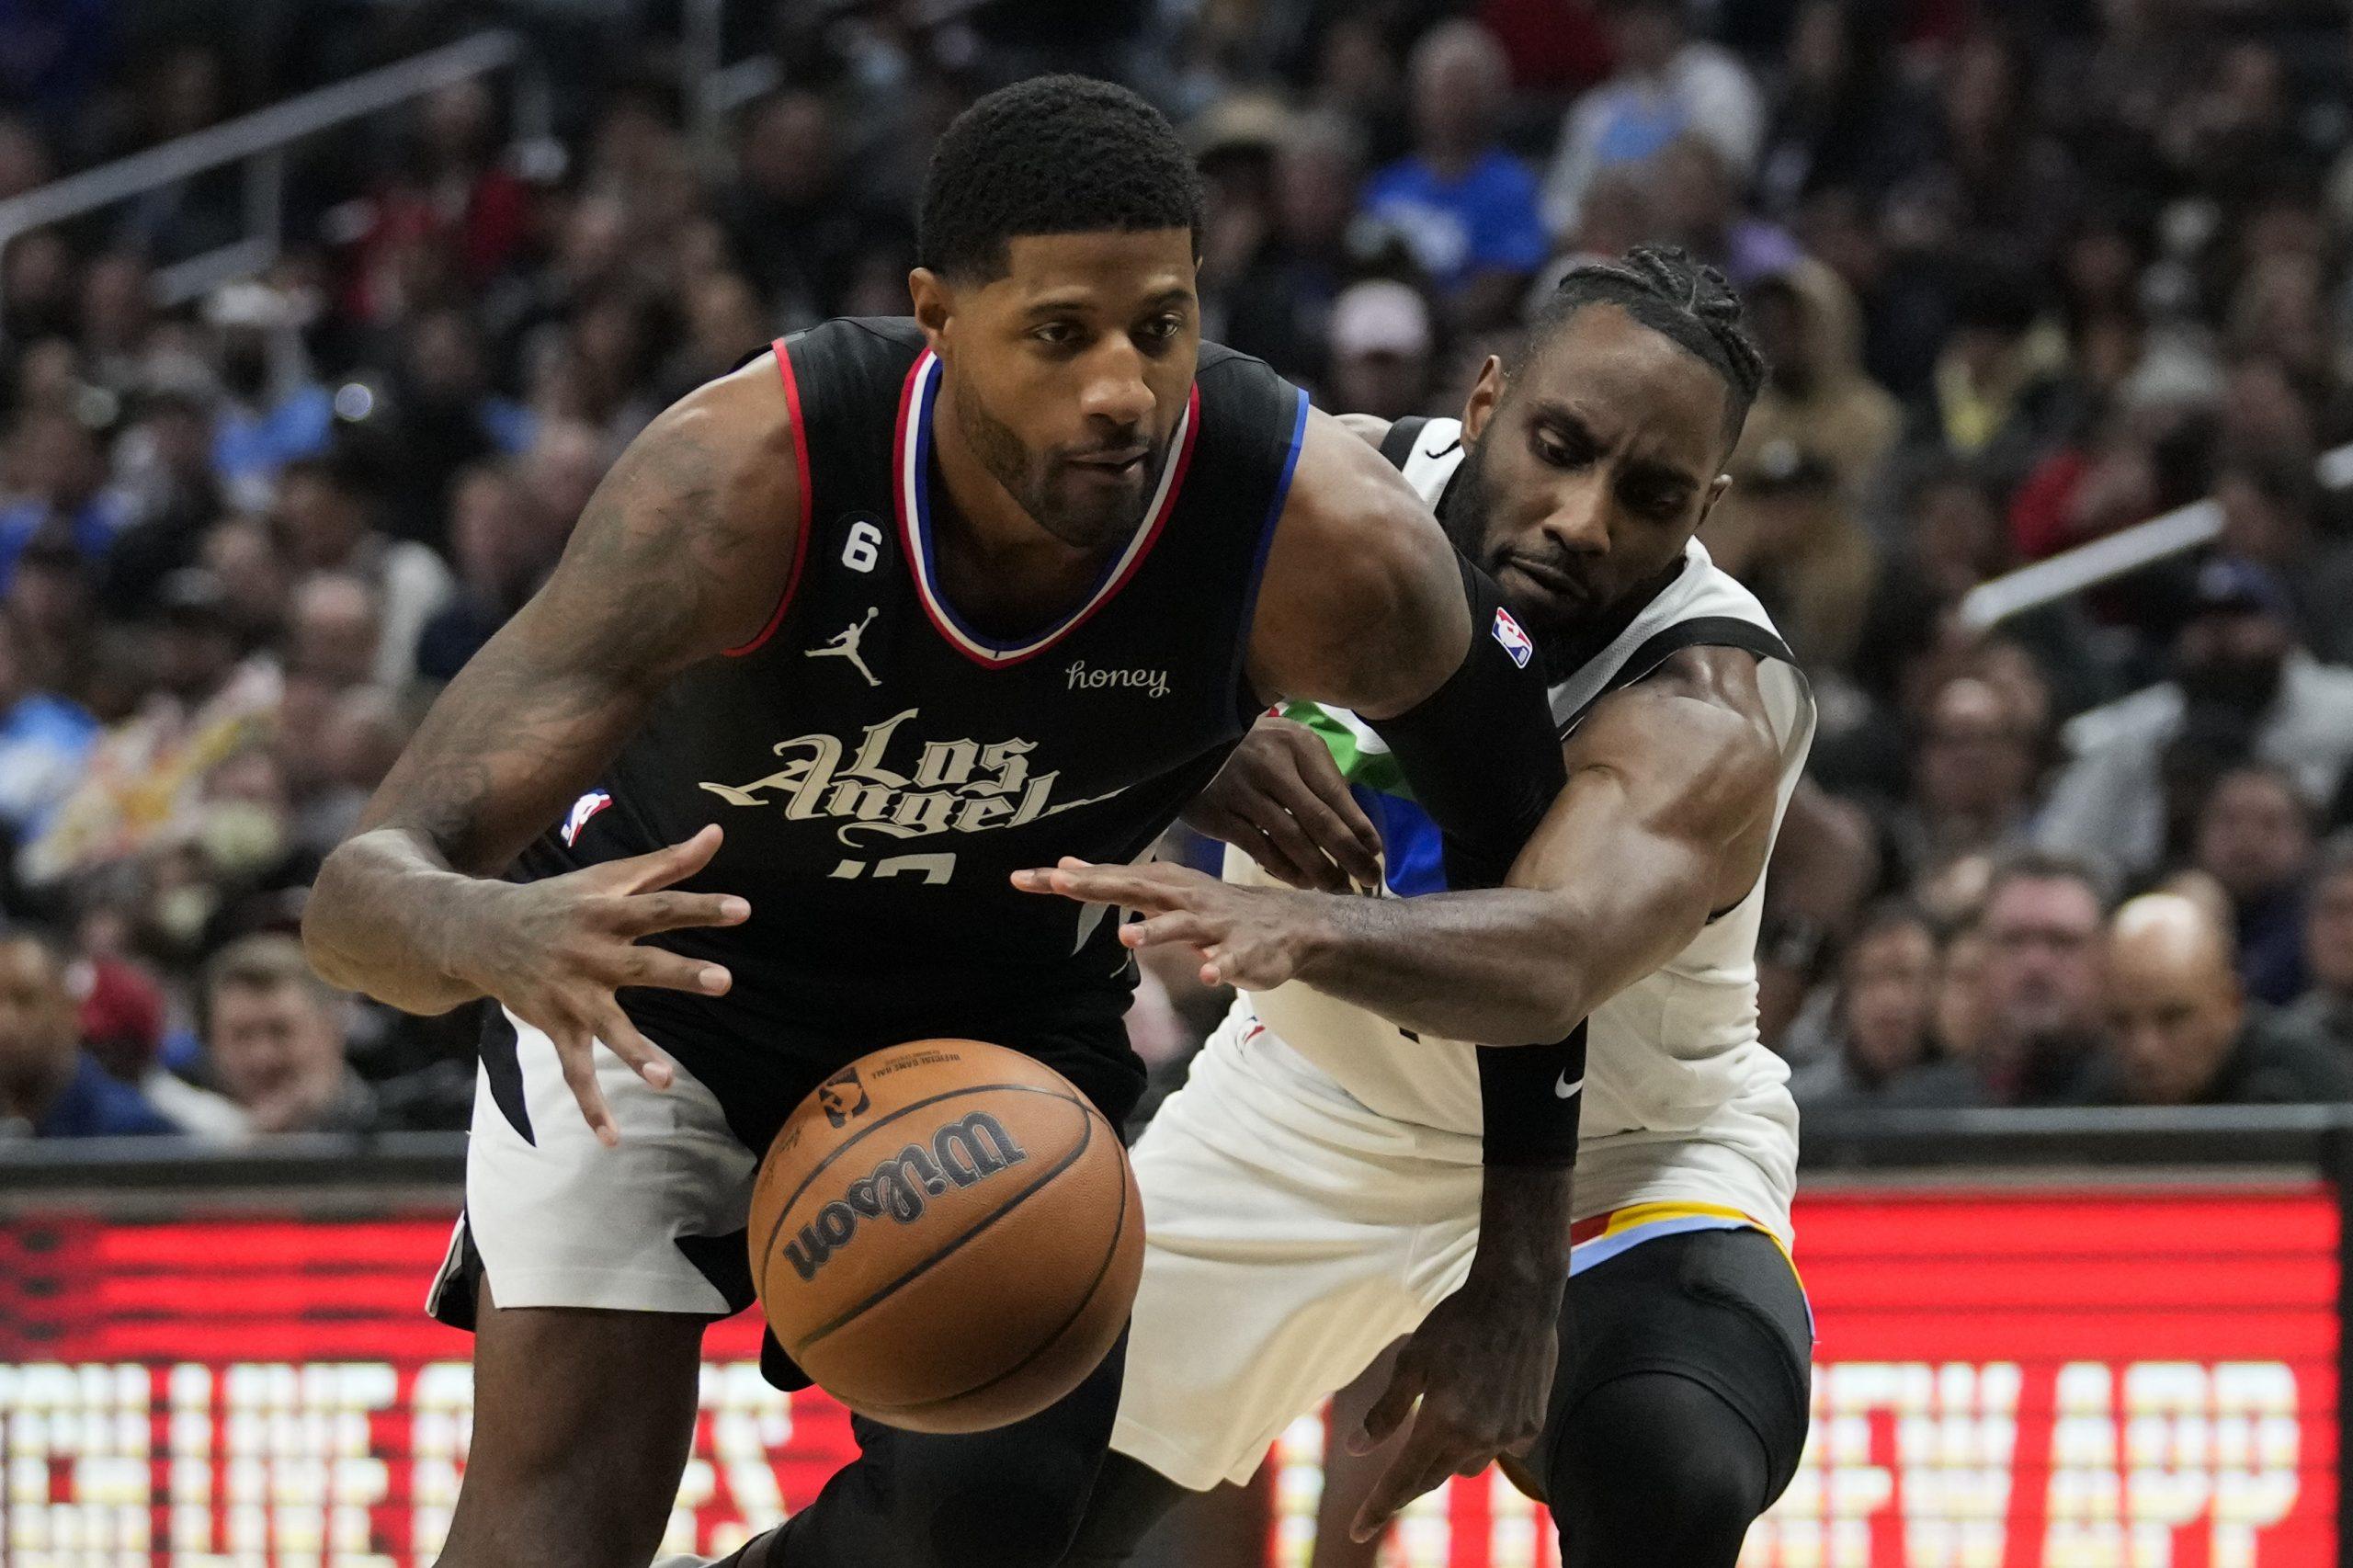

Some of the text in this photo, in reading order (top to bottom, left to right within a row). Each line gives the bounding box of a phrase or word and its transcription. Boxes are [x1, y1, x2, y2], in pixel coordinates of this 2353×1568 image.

[842, 520, 883, 574] 6
[1065, 660, 1171, 699] honey
[699, 733, 1136, 847] Angel
[835, 707, 1039, 797] Los
[781, 1110, 1029, 1281] Wilson
